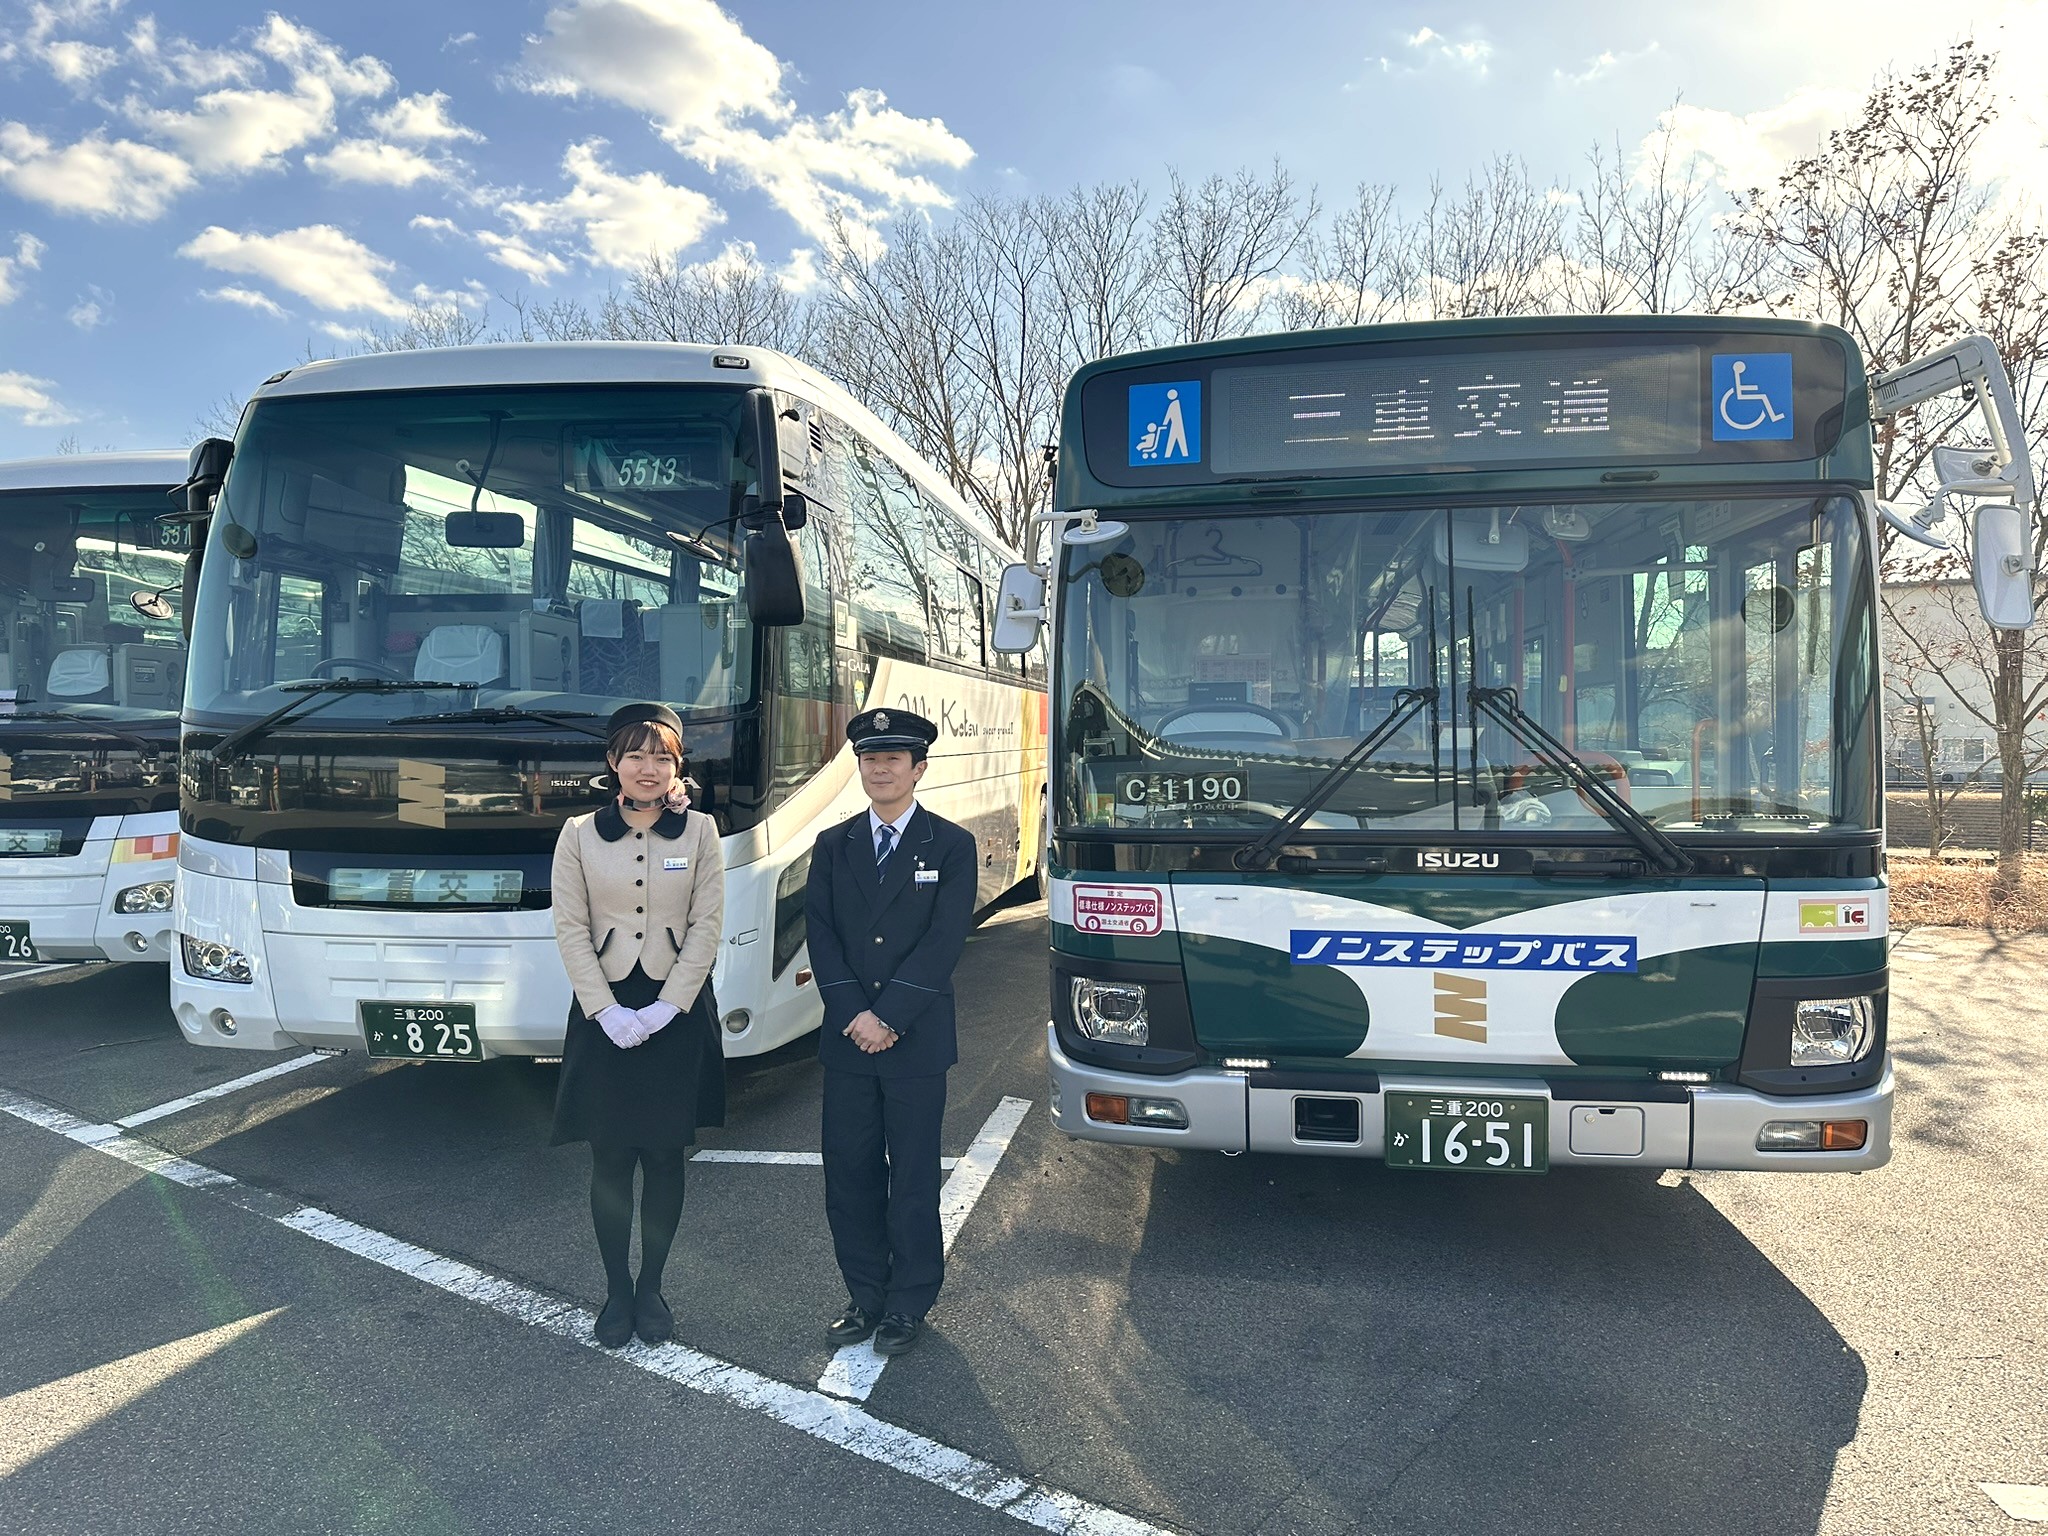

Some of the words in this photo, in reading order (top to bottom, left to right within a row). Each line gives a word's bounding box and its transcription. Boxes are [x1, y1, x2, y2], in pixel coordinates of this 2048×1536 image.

[1284, 375, 1609, 443] 三重交通
[618, 457, 678, 486] 5513
[847, 658, 871, 674] GALA
[1126, 777, 1242, 802] C-1190
[1417, 853, 1499, 868] ISUZU
[336, 872, 521, 901] 三重交通
[4, 935, 32, 957] 26
[1297, 937, 1630, 967] ノンステップバス
[1393, 1132, 1409, 1147] か
[1422, 1118, 1532, 1168] 16-51
